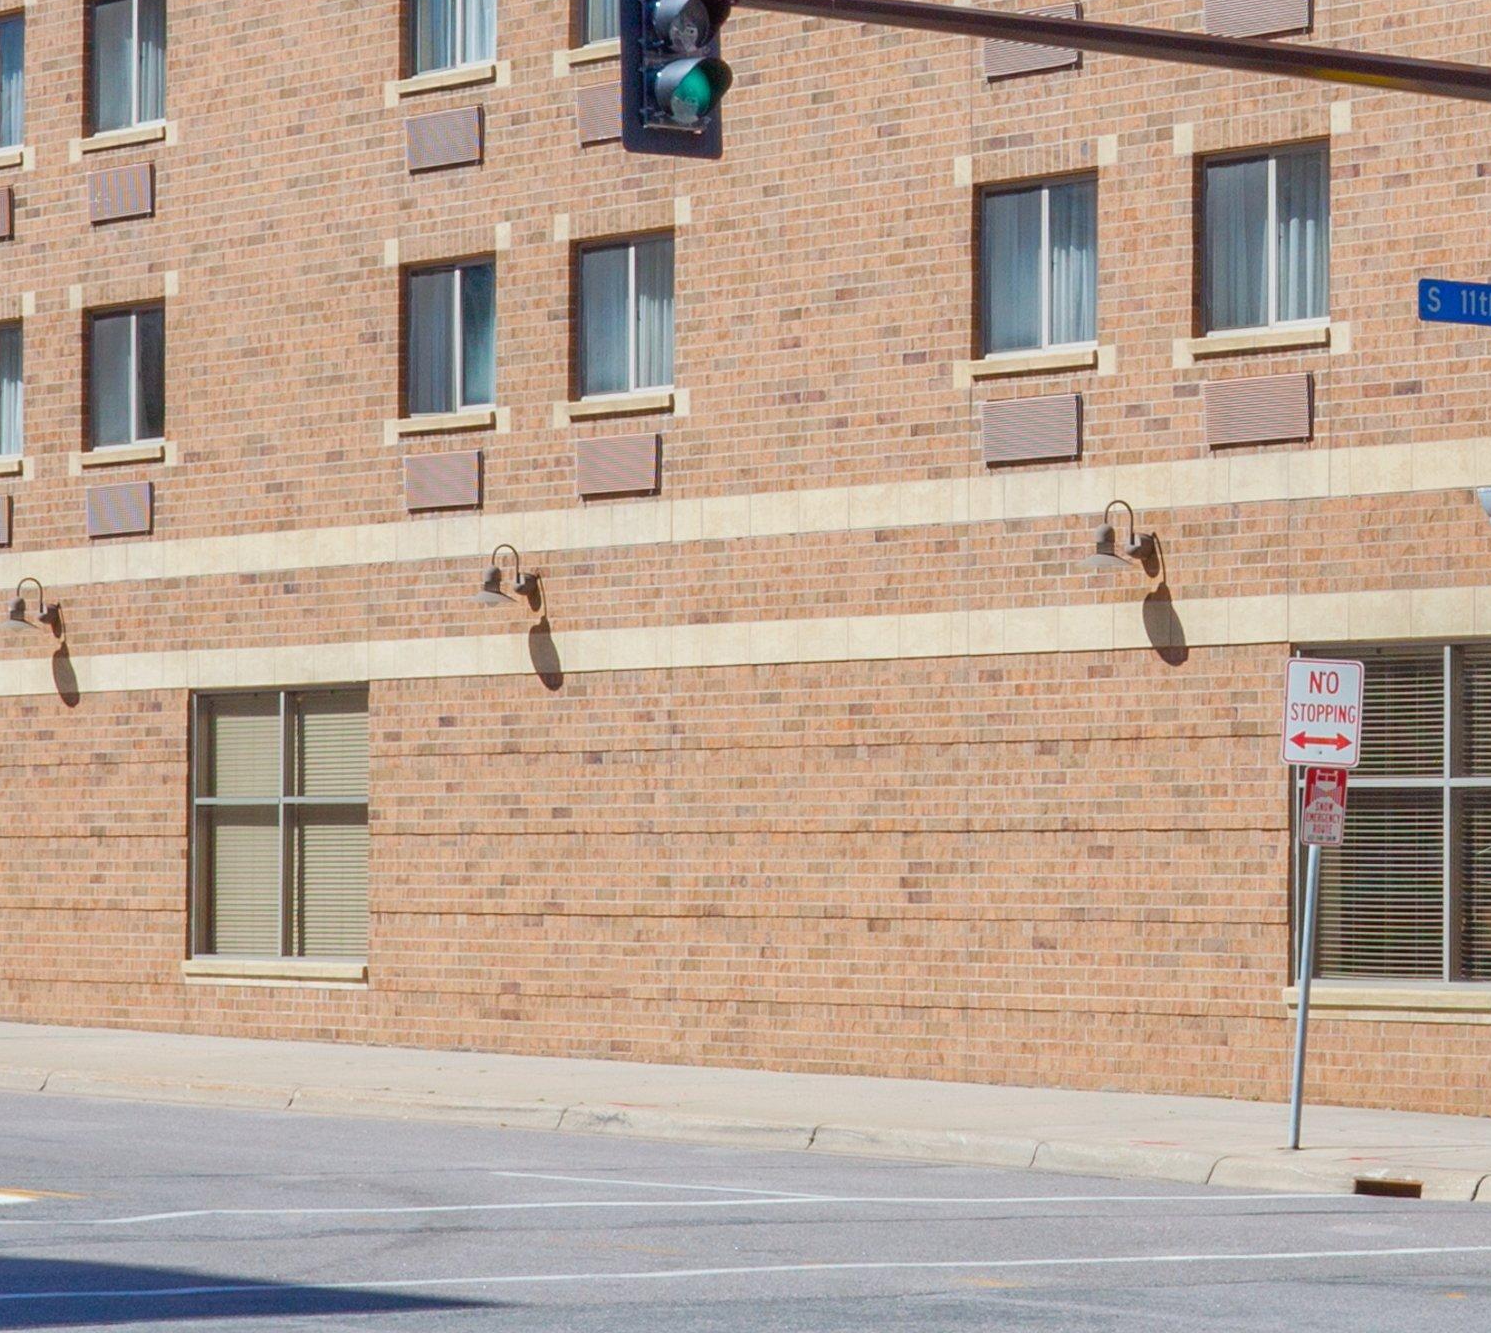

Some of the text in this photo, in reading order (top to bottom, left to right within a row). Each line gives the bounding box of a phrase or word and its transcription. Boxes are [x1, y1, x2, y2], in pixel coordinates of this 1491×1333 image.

[1427, 286, 1441, 312] S
[1309, 670, 1339, 694] NO
[1290, 702, 1356, 724] STOPPING
